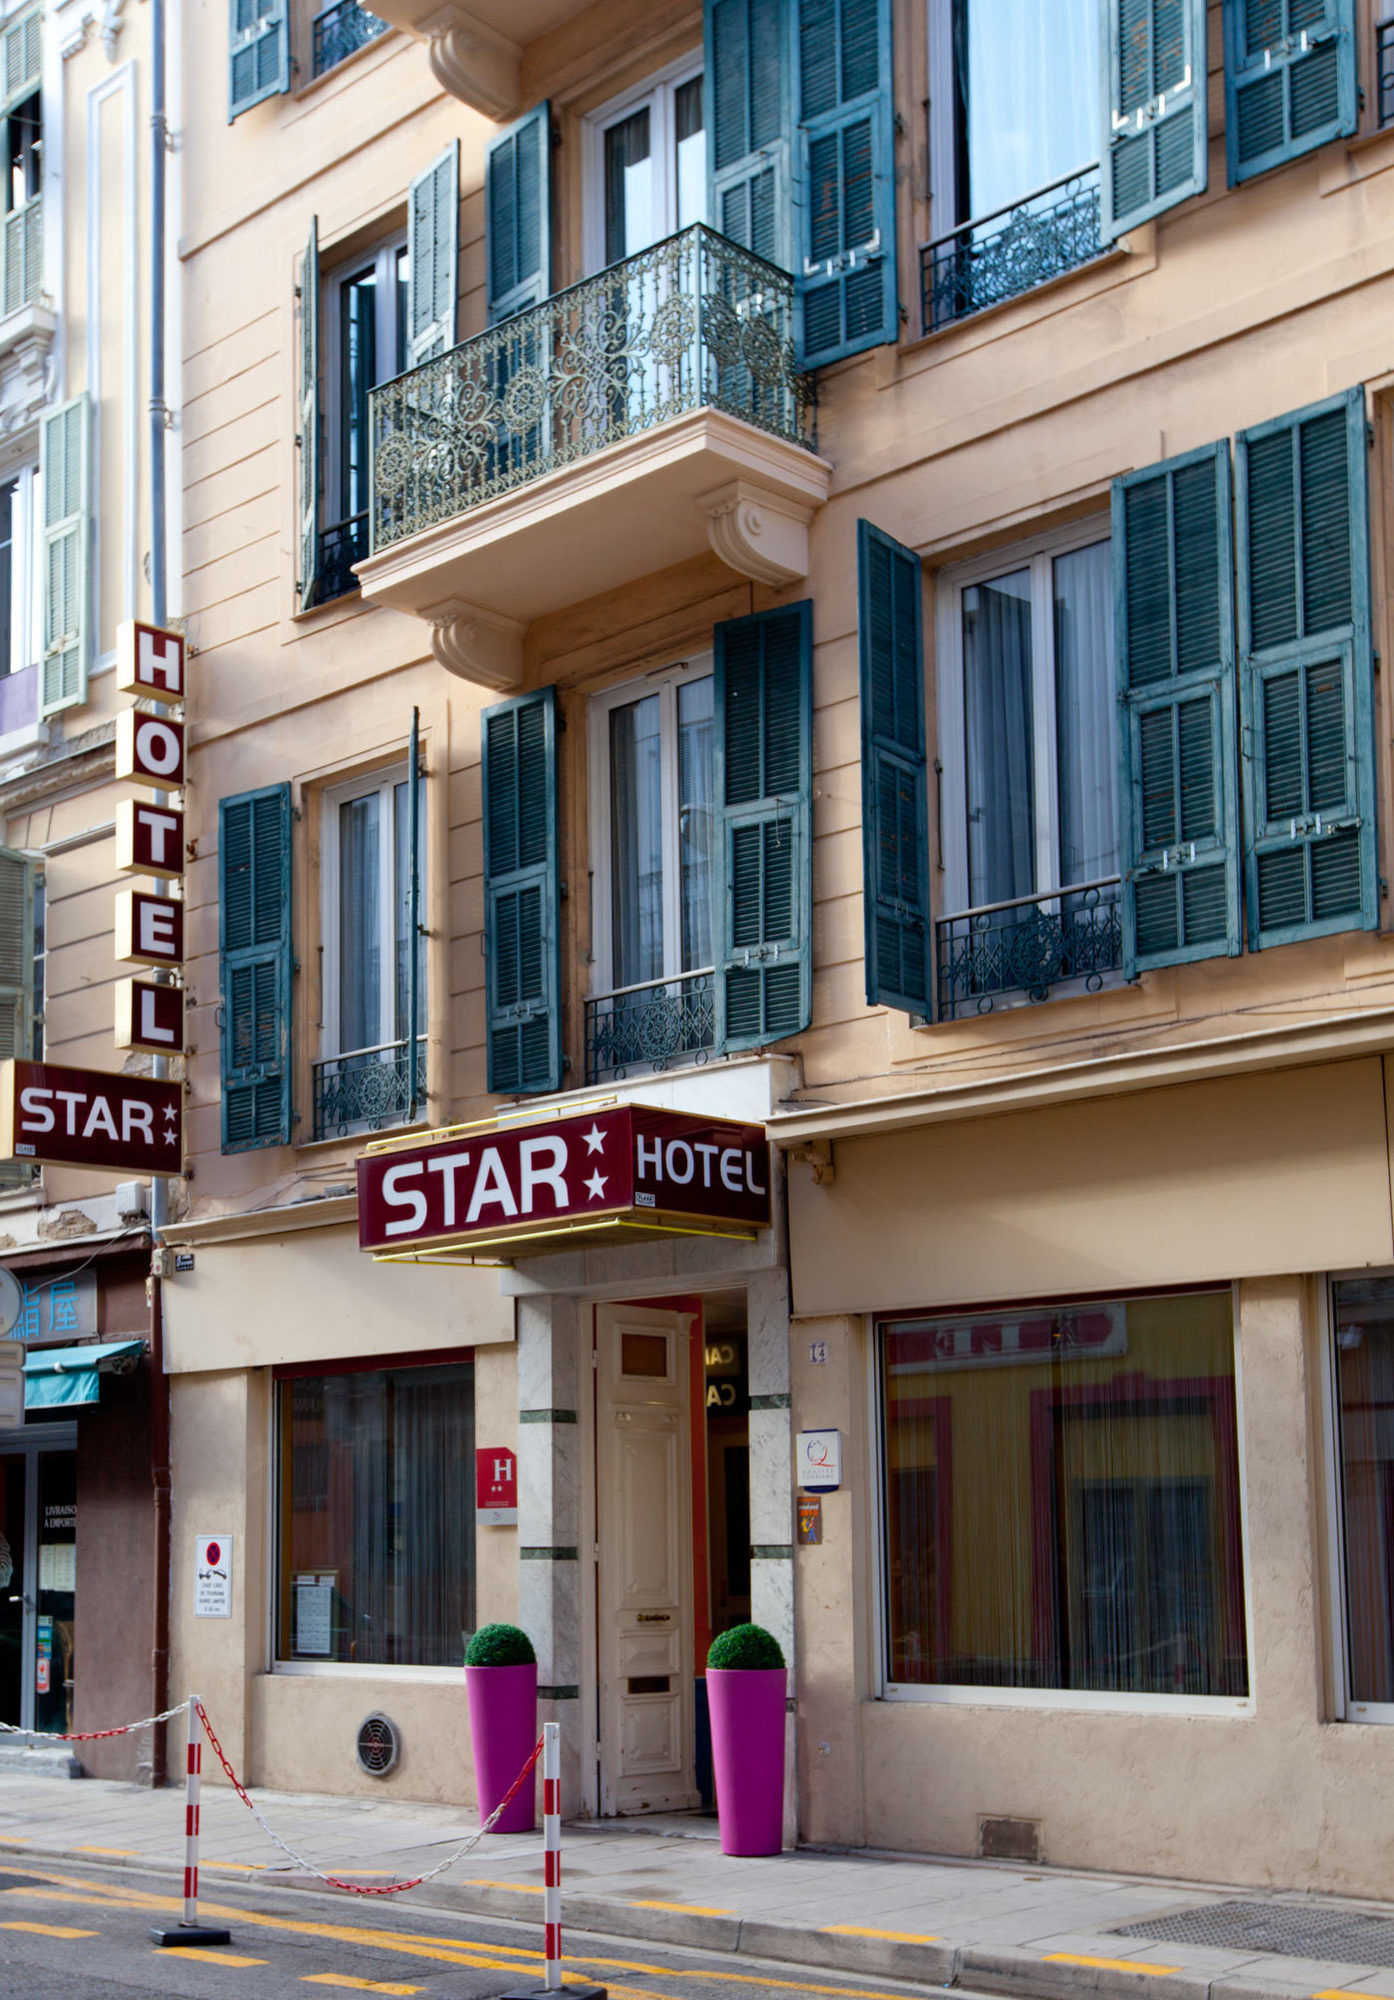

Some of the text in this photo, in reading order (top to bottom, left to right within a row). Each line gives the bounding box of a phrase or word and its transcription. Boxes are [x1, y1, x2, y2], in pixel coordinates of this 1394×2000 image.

[136, 632, 181, 1042] HOTEL
[20, 1087, 154, 1145] STAR
[381, 1135, 570, 1237] STAR
[636, 1134, 766, 1196] HOTEL
[493, 1459, 512, 1481] H
